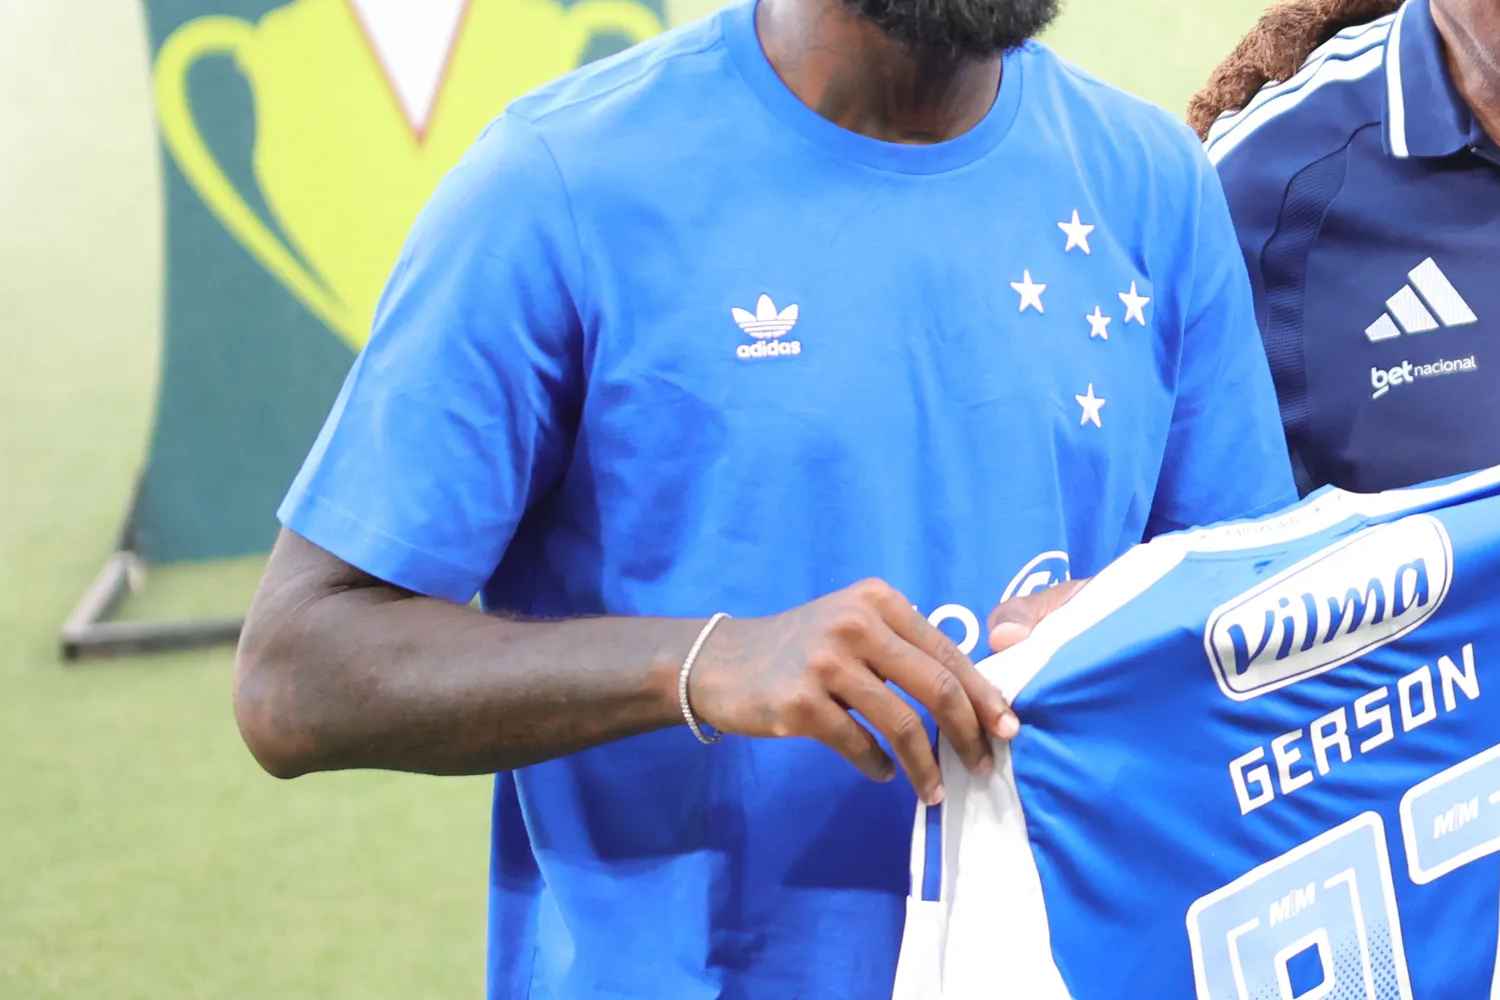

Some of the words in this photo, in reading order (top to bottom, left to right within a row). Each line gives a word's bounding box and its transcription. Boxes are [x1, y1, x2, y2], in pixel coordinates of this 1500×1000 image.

[736, 339, 801, 358] adidas
[1227, 557, 1429, 675] Vilma
[1229, 642, 1481, 816] GERSON
